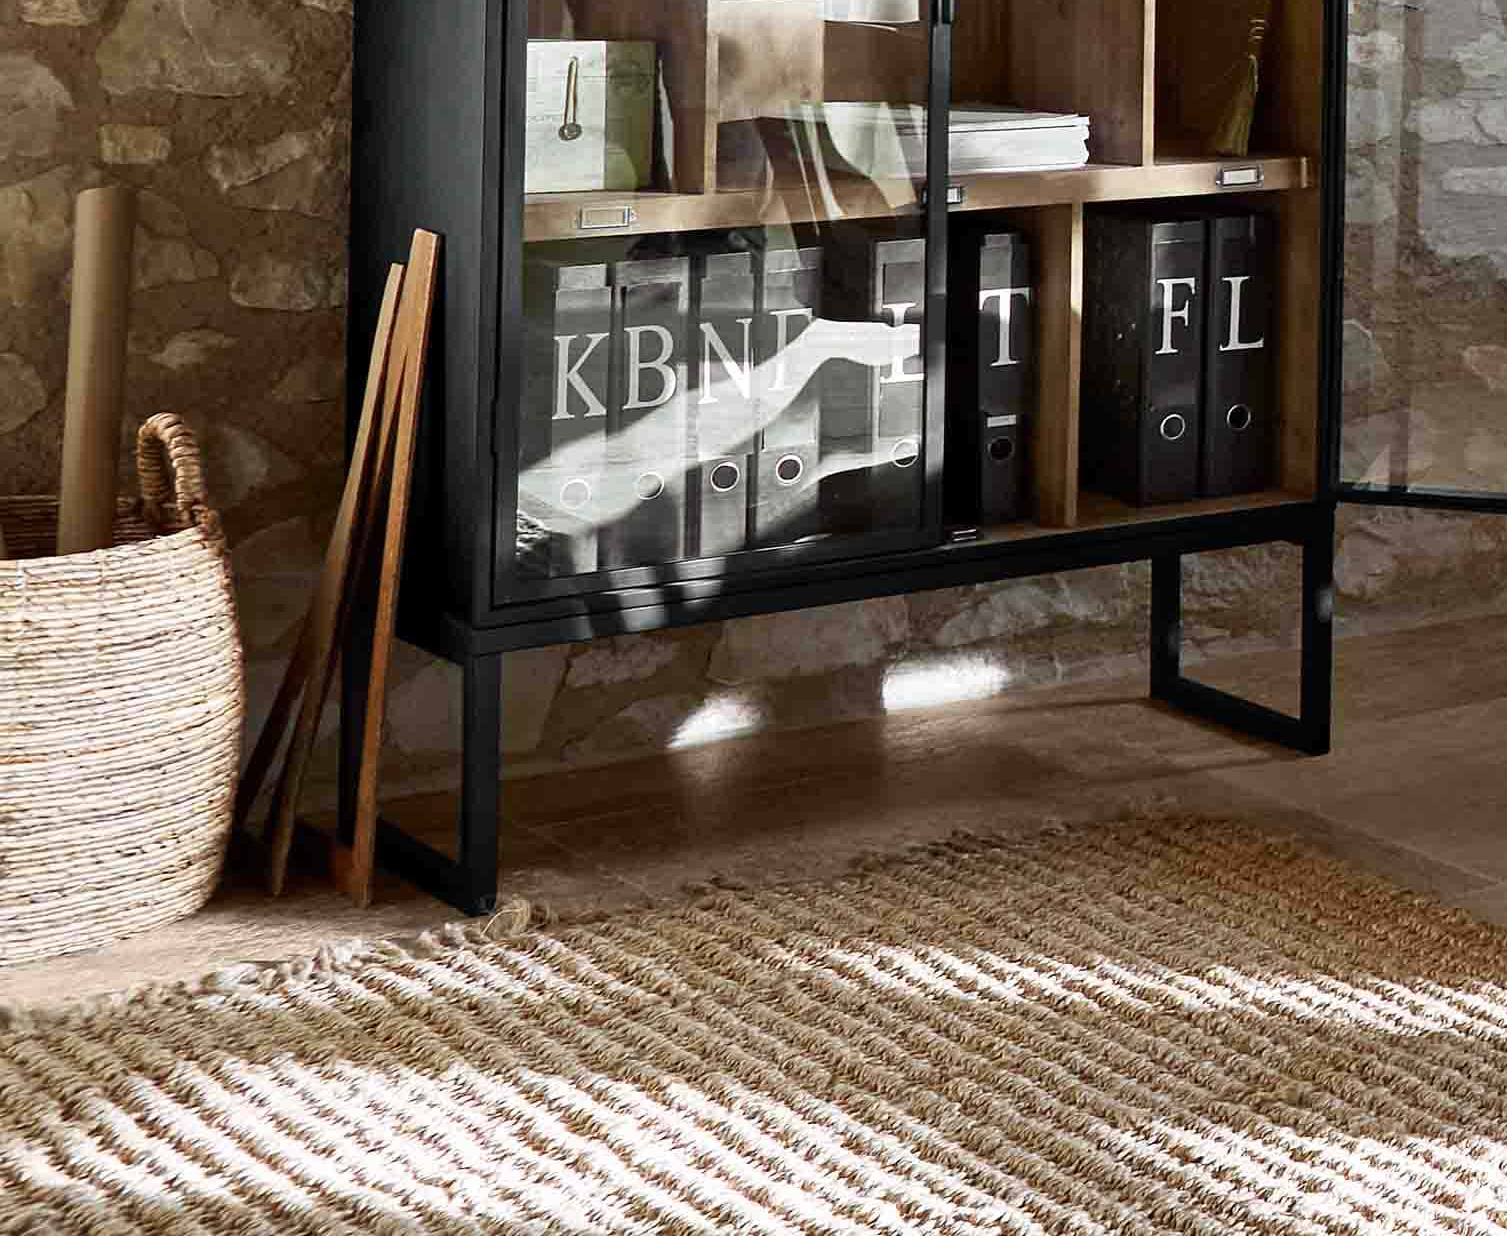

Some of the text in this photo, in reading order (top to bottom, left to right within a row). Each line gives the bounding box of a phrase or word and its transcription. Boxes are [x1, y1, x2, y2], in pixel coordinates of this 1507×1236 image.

[979, 286, 1031, 367] T
[1155, 276, 1197, 355] F
[1219, 275, 1265, 352] L
[552, 332, 611, 420] K
[622, 324, 678, 410] B
[697, 318, 753, 405] N
